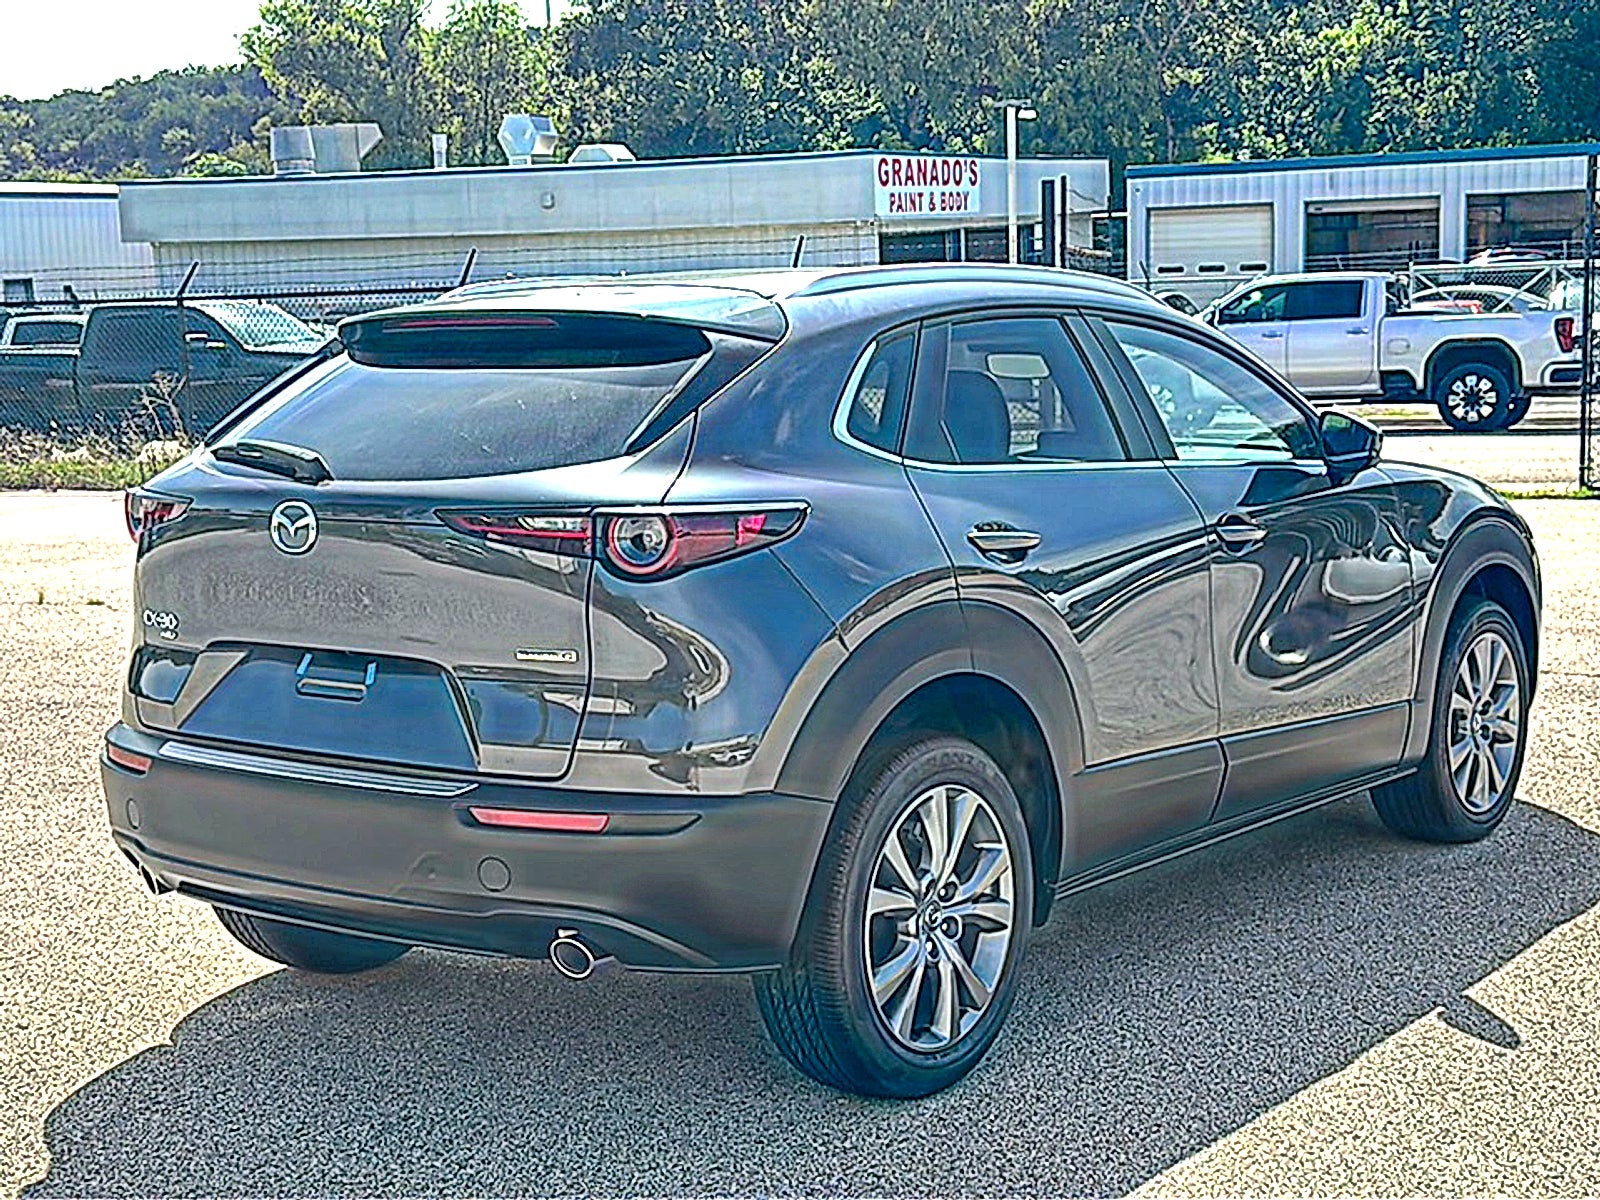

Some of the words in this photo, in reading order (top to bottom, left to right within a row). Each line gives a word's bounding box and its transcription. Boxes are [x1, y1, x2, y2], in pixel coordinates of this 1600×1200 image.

[878, 157, 978, 187] GRANADO'S
[889, 191, 924, 213] PAINT
[929, 191, 936, 212] &
[940, 190, 970, 212] BODY
